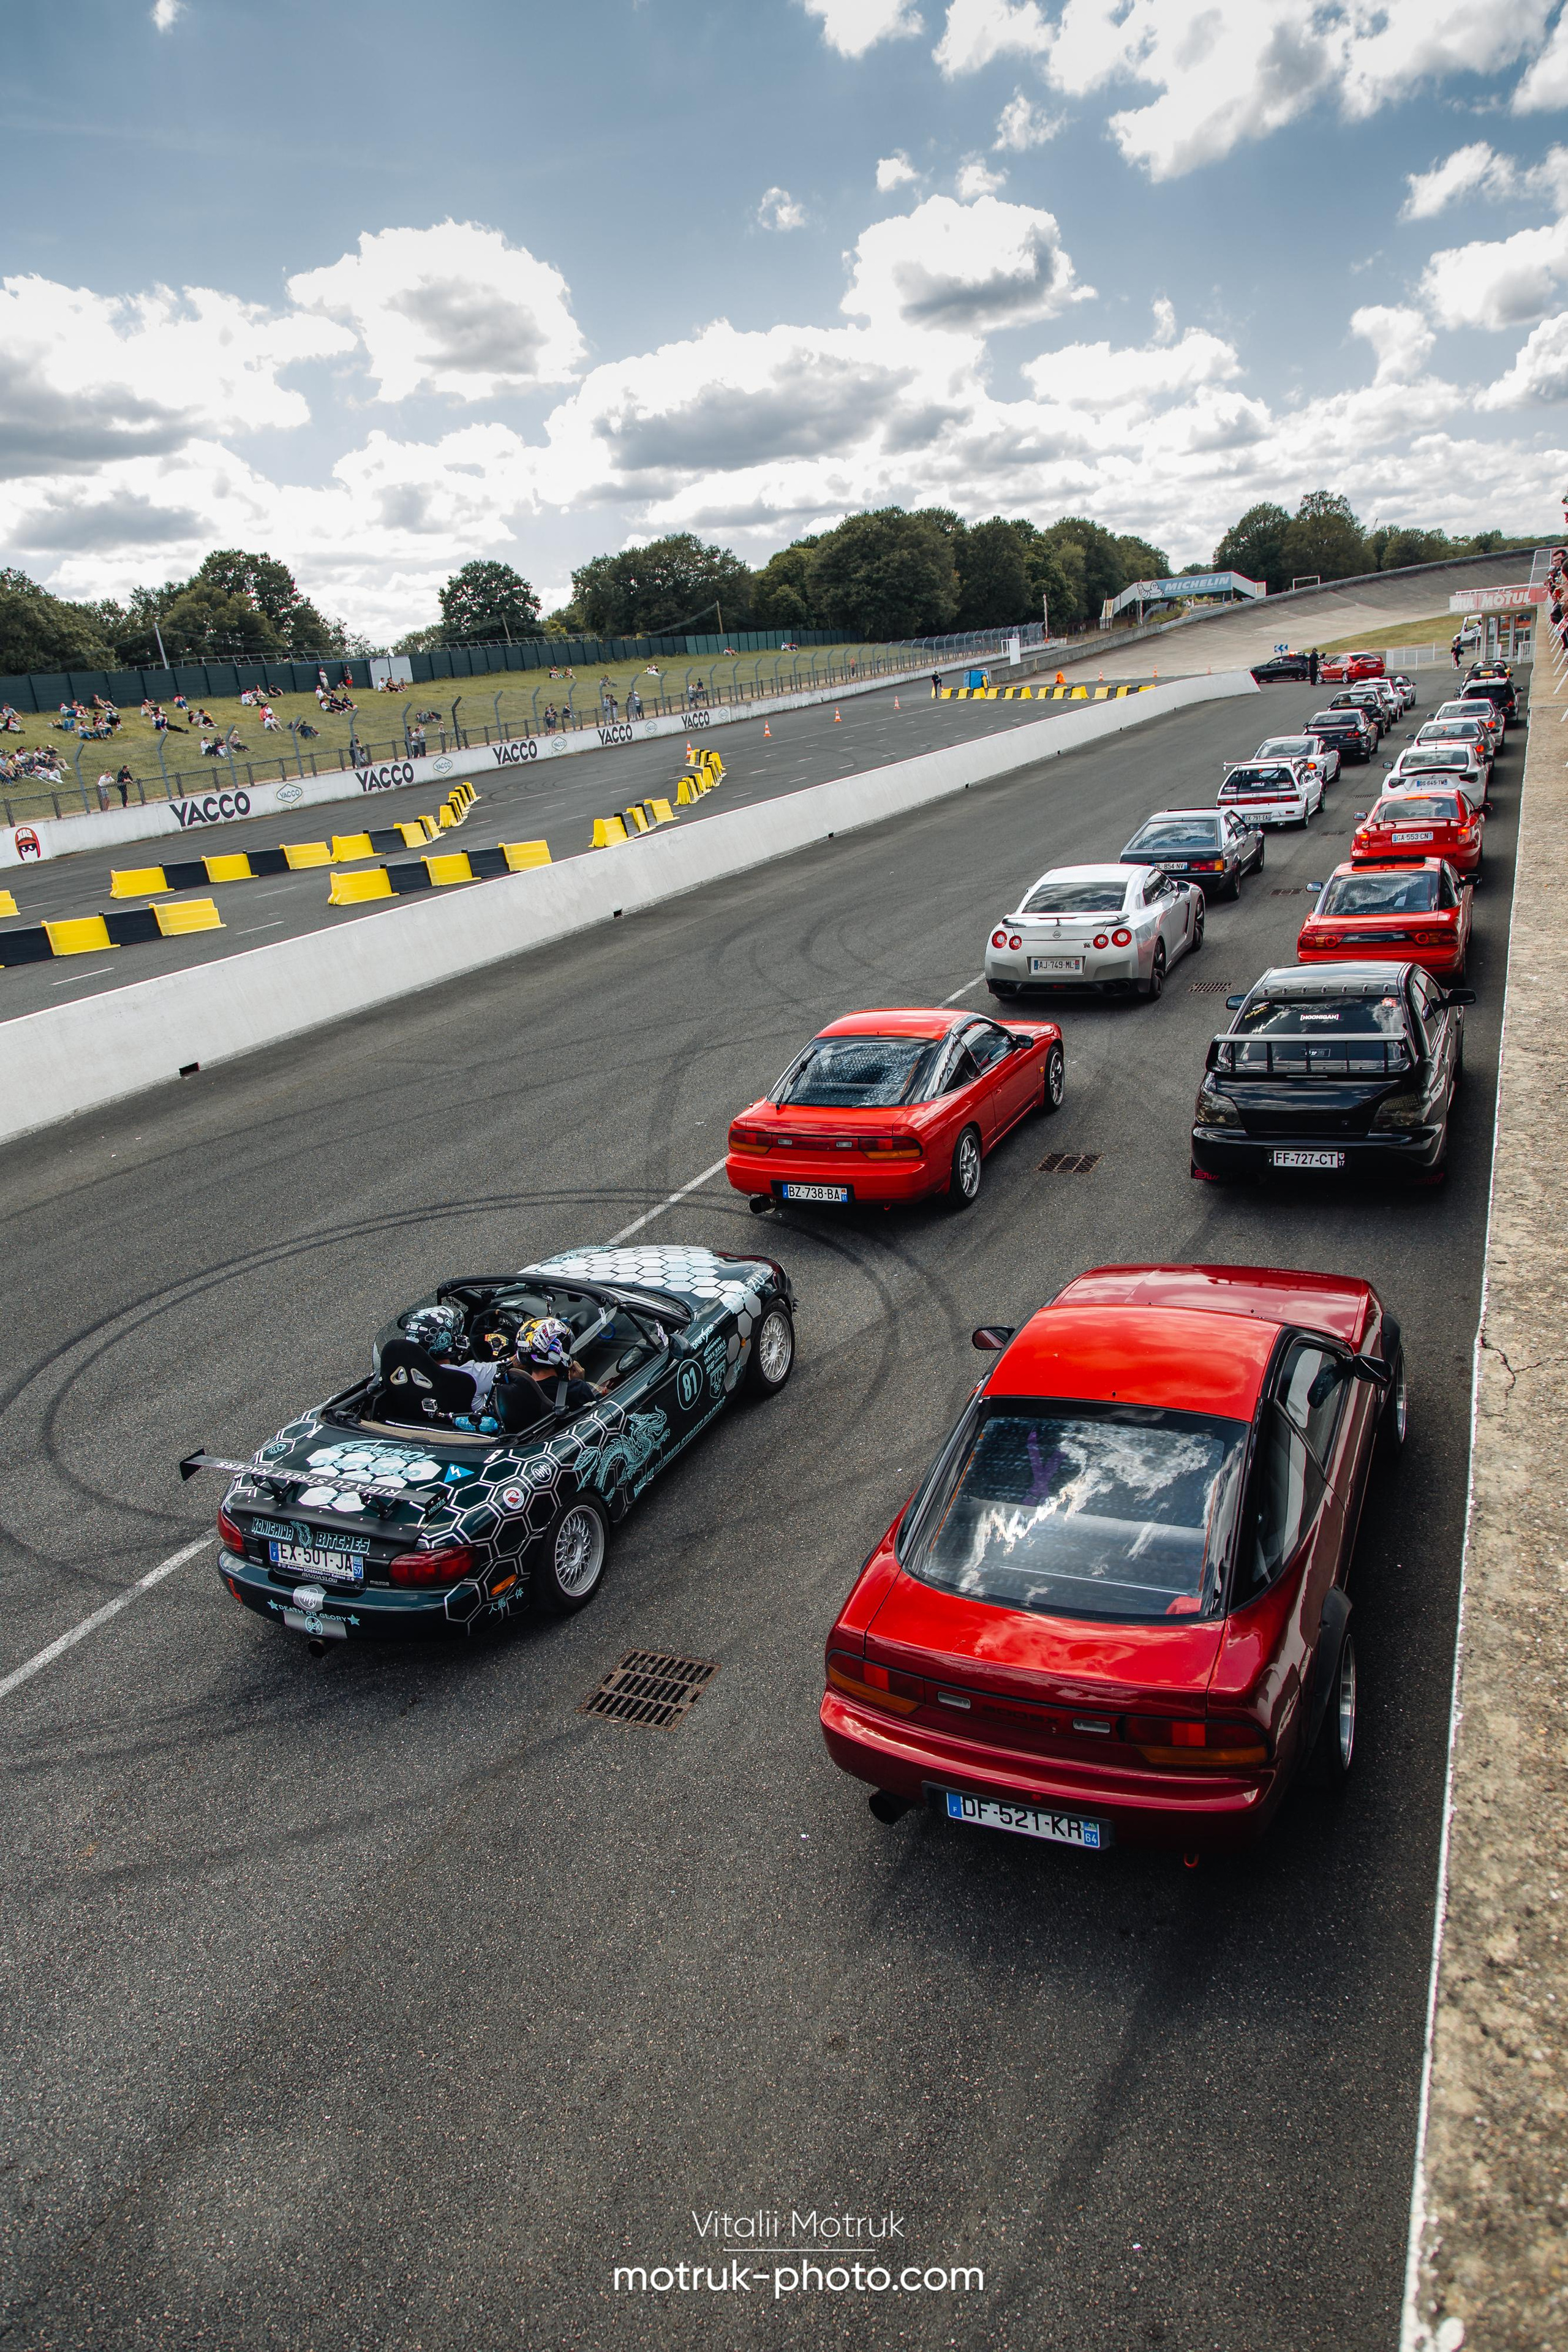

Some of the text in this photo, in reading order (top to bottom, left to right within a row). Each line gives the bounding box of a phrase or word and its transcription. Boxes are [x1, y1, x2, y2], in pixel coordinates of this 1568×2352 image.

[1165, 576, 1229, 591] MICHELIN
[1481, 591, 1531, 607] MOTUL
[682, 710, 709, 729] YACCO
[598, 724, 632, 745] YACCO
[492, 741, 537, 765] YACCO
[355, 763, 414, 793] YACCO
[280, 789, 300, 799] YACCO
[169, 791, 251, 827] YACCO
[1276, 1153, 1335, 1165] FF-727-CT
[789, 1186, 840, 1200] BZ-738-BA
[682, 1366, 697, 1401] 81
[216, 1461, 273, 1476] RACERS
[272, 1471, 329, 1485] STREET
[327, 1478, 402, 1497] RIBAZU
[315, 1531, 371, 1554] BITCHES
[281, 1542, 353, 1572] EX-501-JA
[354, 1565, 362, 1575] 57
[279, 1604, 304, 1615] DEATH
[319, 1613, 347, 1623] GLORY
[962, 1798, 1082, 1839] DF-521-KR
[1085, 1833, 1097, 1844] 64
